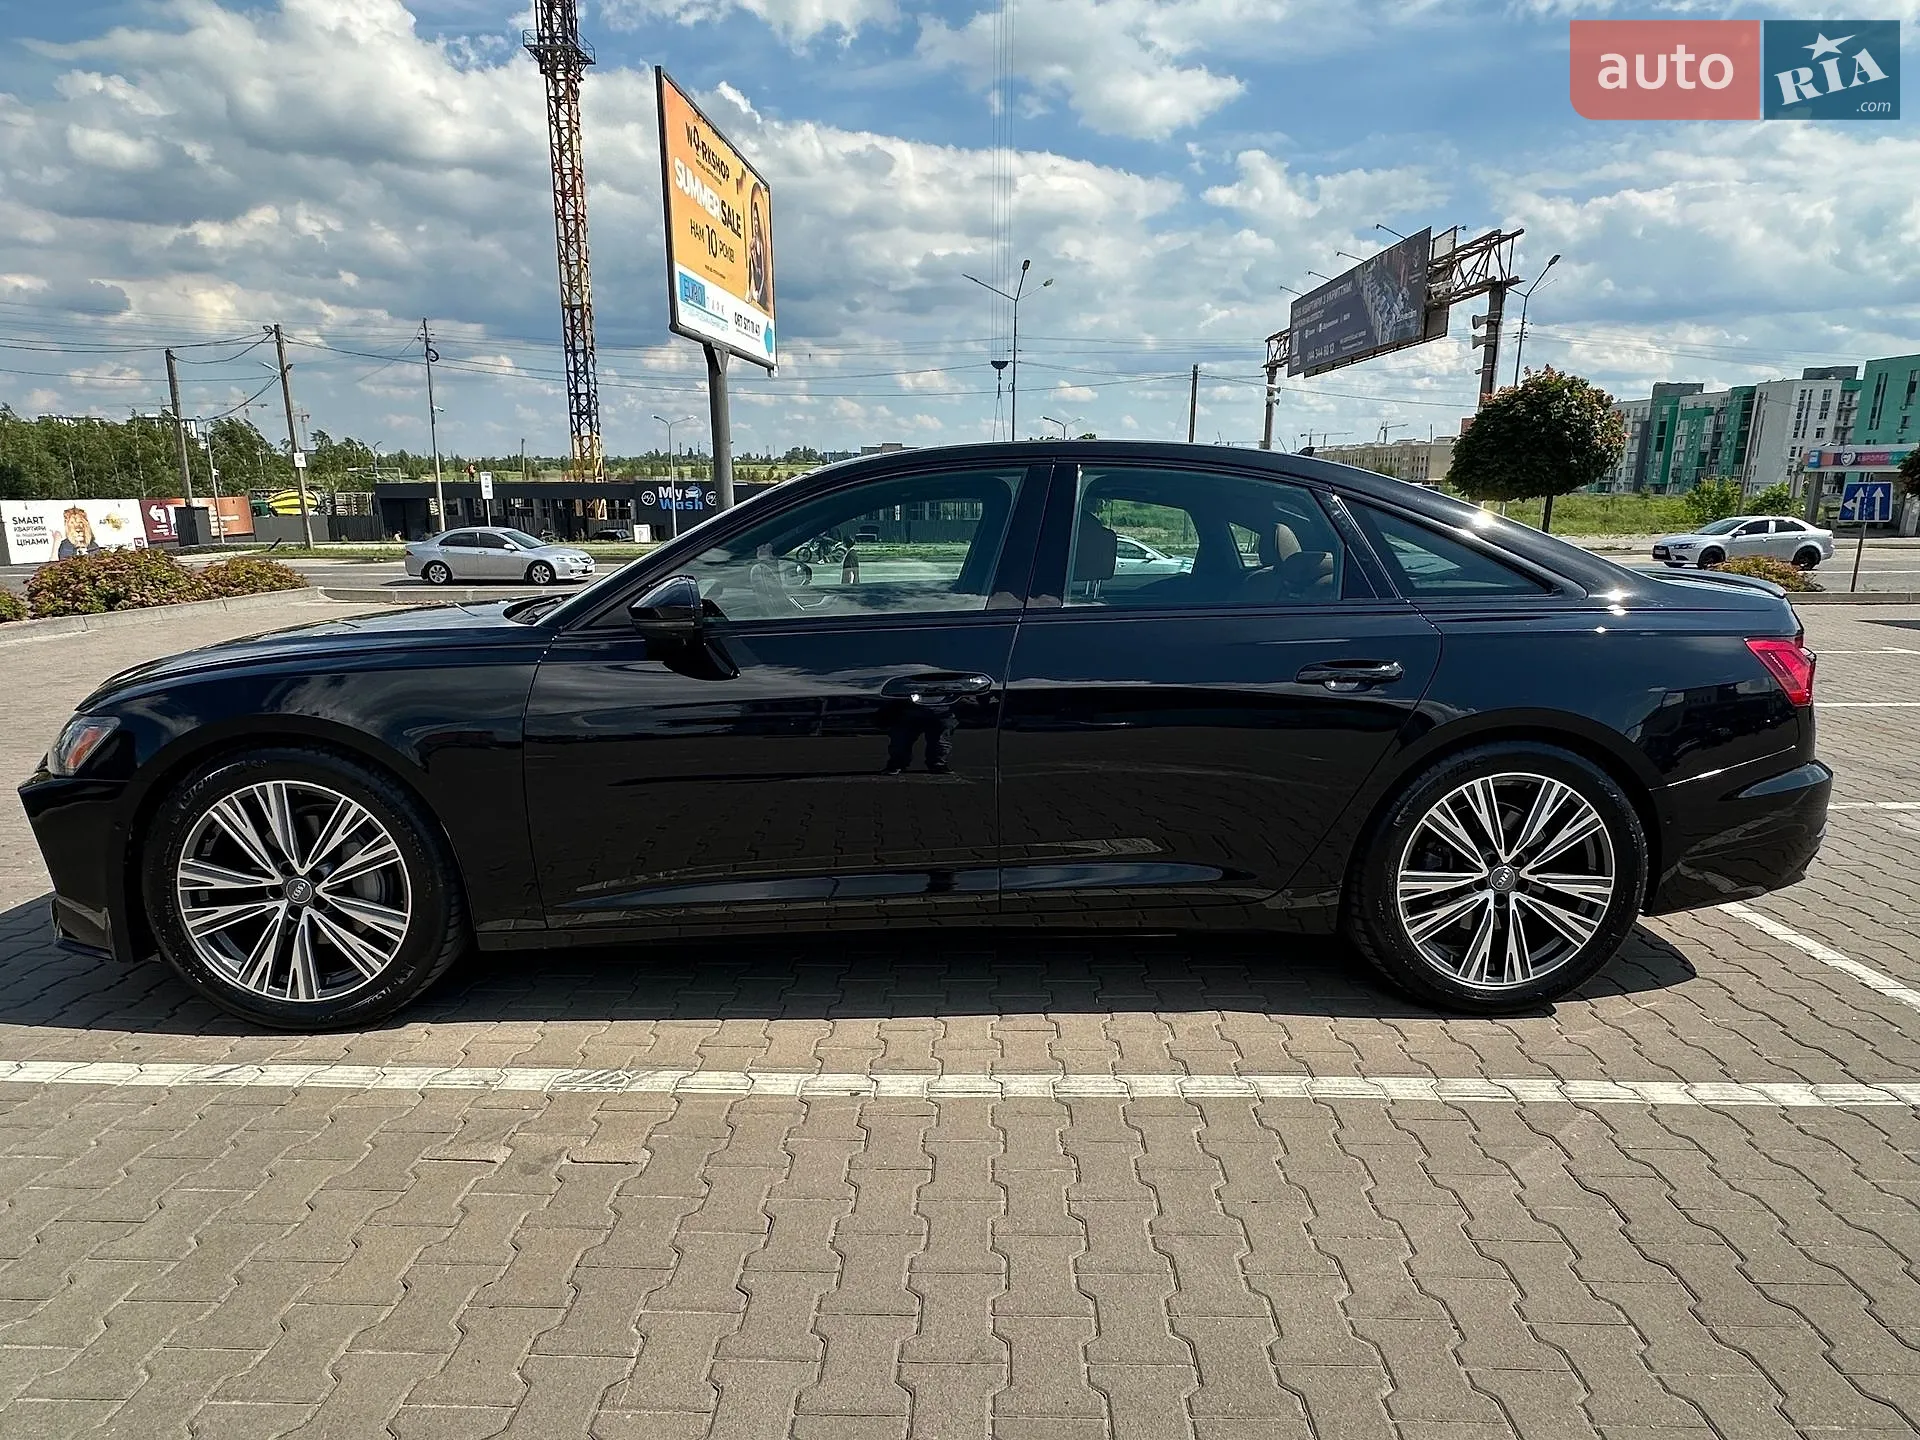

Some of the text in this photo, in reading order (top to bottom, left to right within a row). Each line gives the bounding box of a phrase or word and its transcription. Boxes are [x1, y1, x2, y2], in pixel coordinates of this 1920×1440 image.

[674, 156, 720, 220] SUMMER
[720, 199, 742, 239] SALE
[705, 223, 718, 259] 10
[658, 486, 683, 500] My
[659, 498, 704, 510] Wash
[12, 516, 44, 525] SMART
[16, 538, 49, 547] ЦІНАМИ
